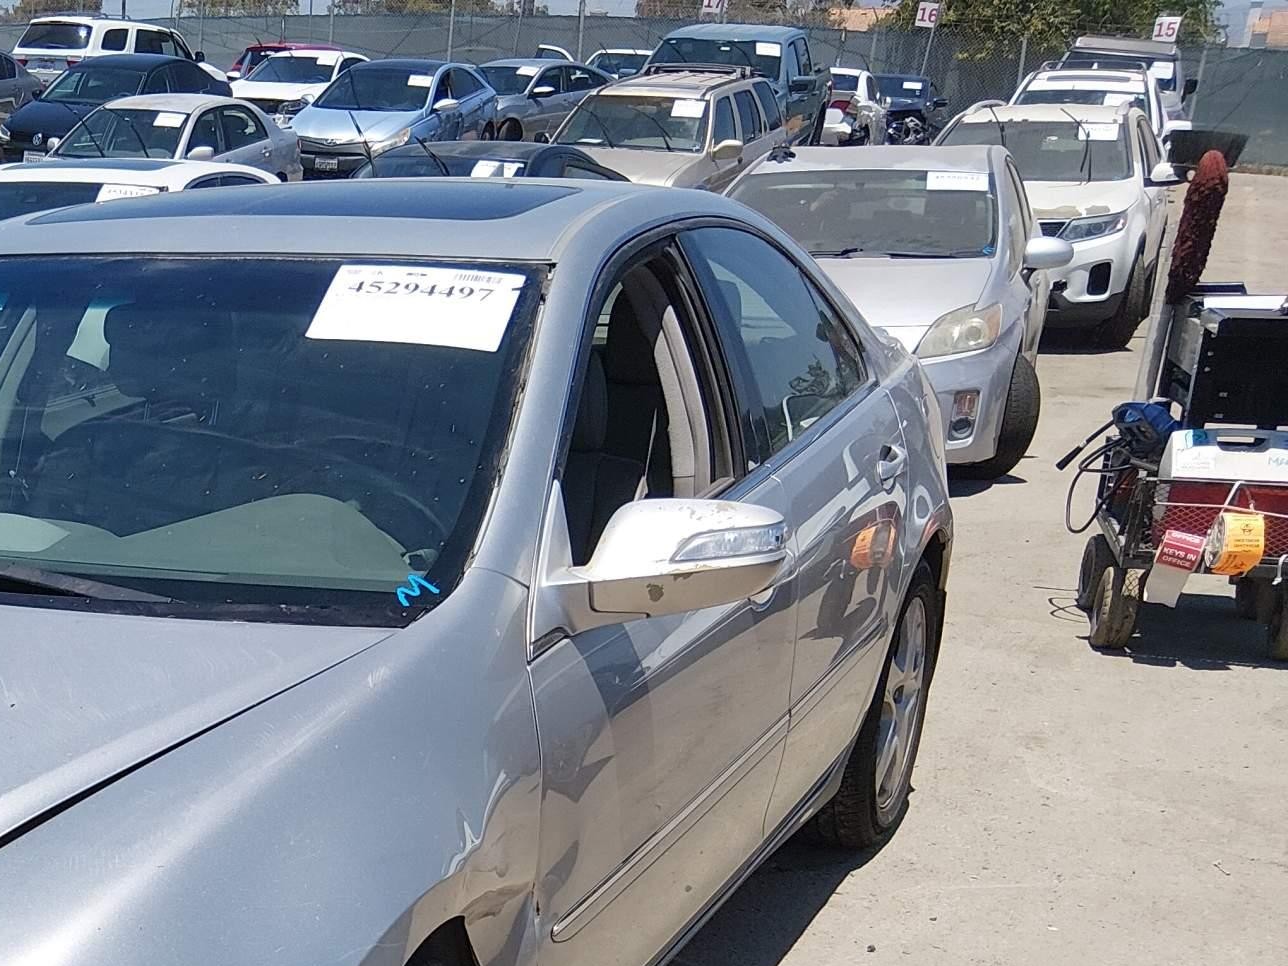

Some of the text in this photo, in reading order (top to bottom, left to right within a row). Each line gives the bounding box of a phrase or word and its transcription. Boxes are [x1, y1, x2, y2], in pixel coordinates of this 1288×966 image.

[917, 7, 938, 23] 16
[1154, 21, 1178, 38] 15
[347, 280, 495, 302] 45294497
[1162, 545, 1197, 562] KEYS IN
[1162, 554, 1192, 569] OFFICE
